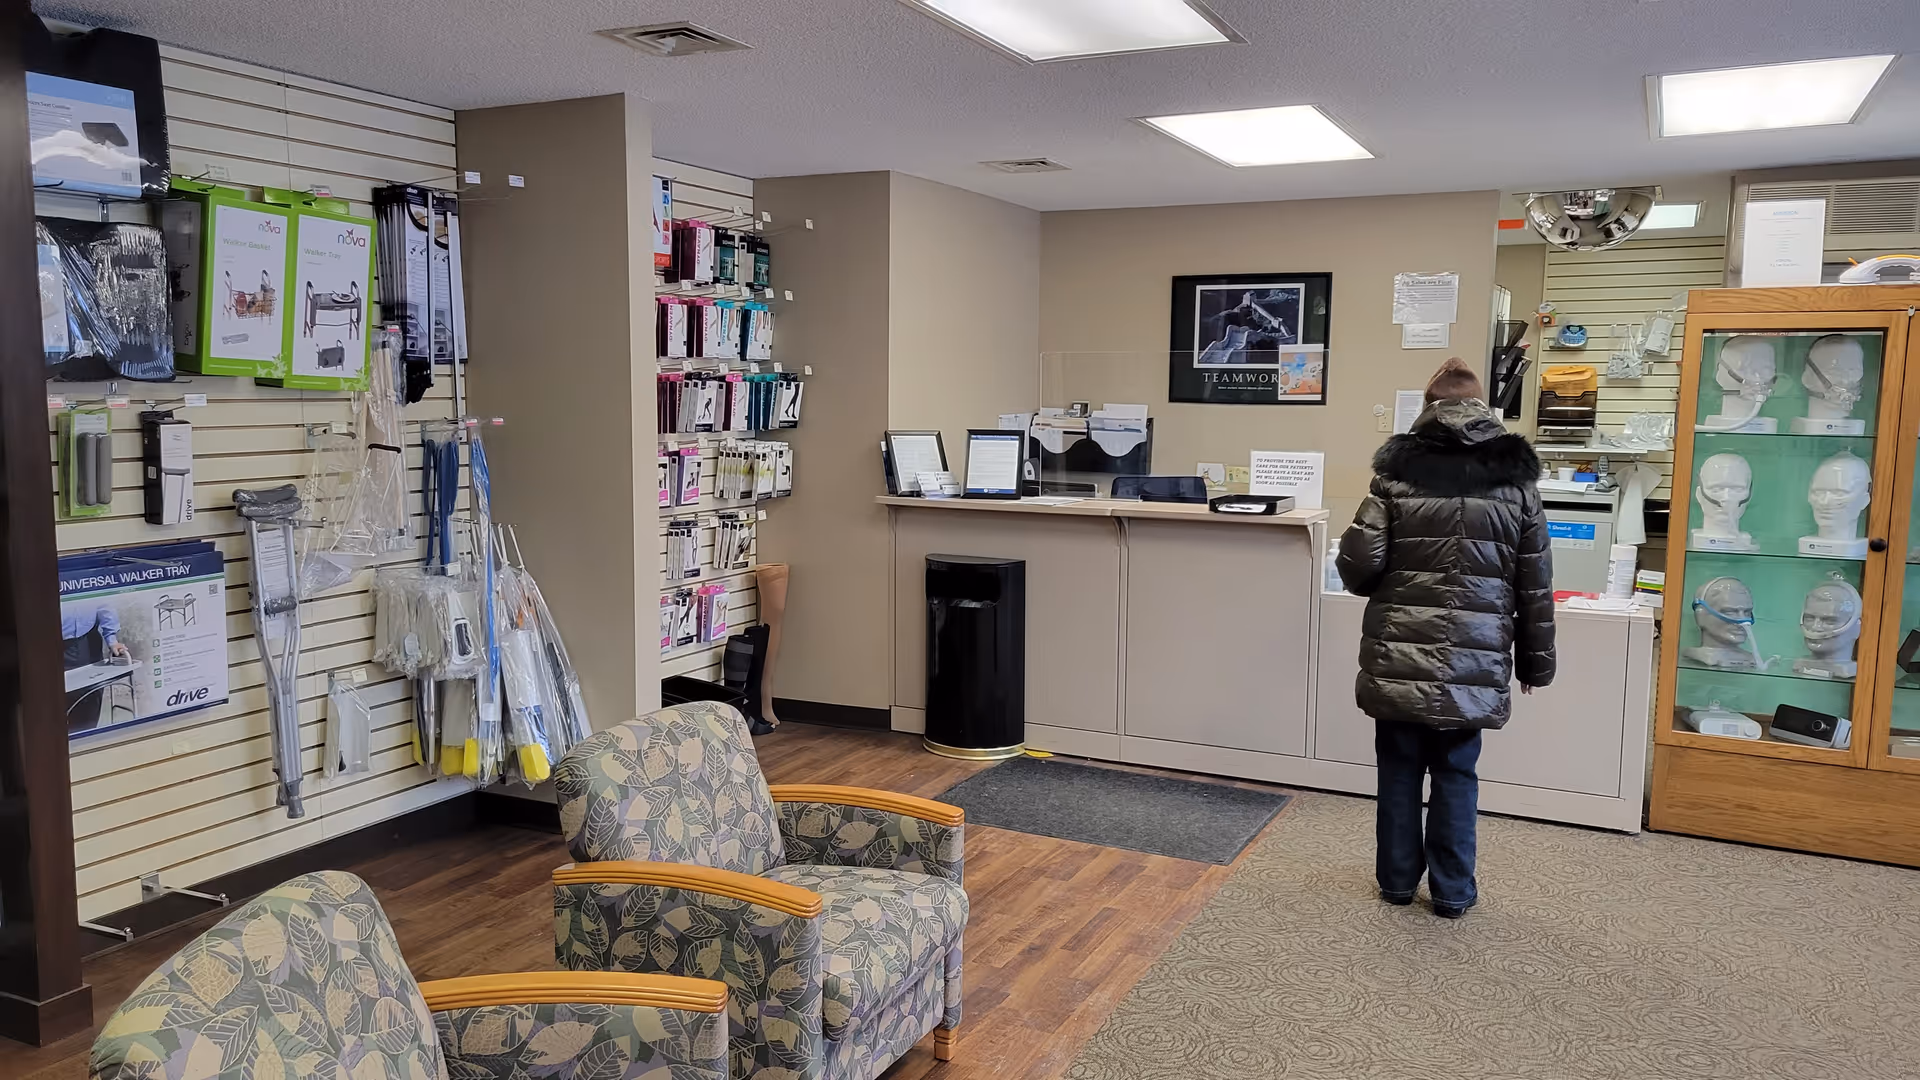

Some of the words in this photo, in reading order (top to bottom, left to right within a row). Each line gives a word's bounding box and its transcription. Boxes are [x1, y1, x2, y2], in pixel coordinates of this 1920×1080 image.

[258, 222, 281, 234] nova
[222, 238, 247, 248] Walker
[248, 241, 271, 251] Basket
[337, 232, 366, 248] nova
[303, 248, 327, 257] Walker
[328, 251, 342, 260] Tray
[1202, 373, 1279, 383] TEAMWOR
[119, 568, 164, 583] WALKER
[165, 564, 191, 577] TRAY
[166, 687, 209, 707] drive
